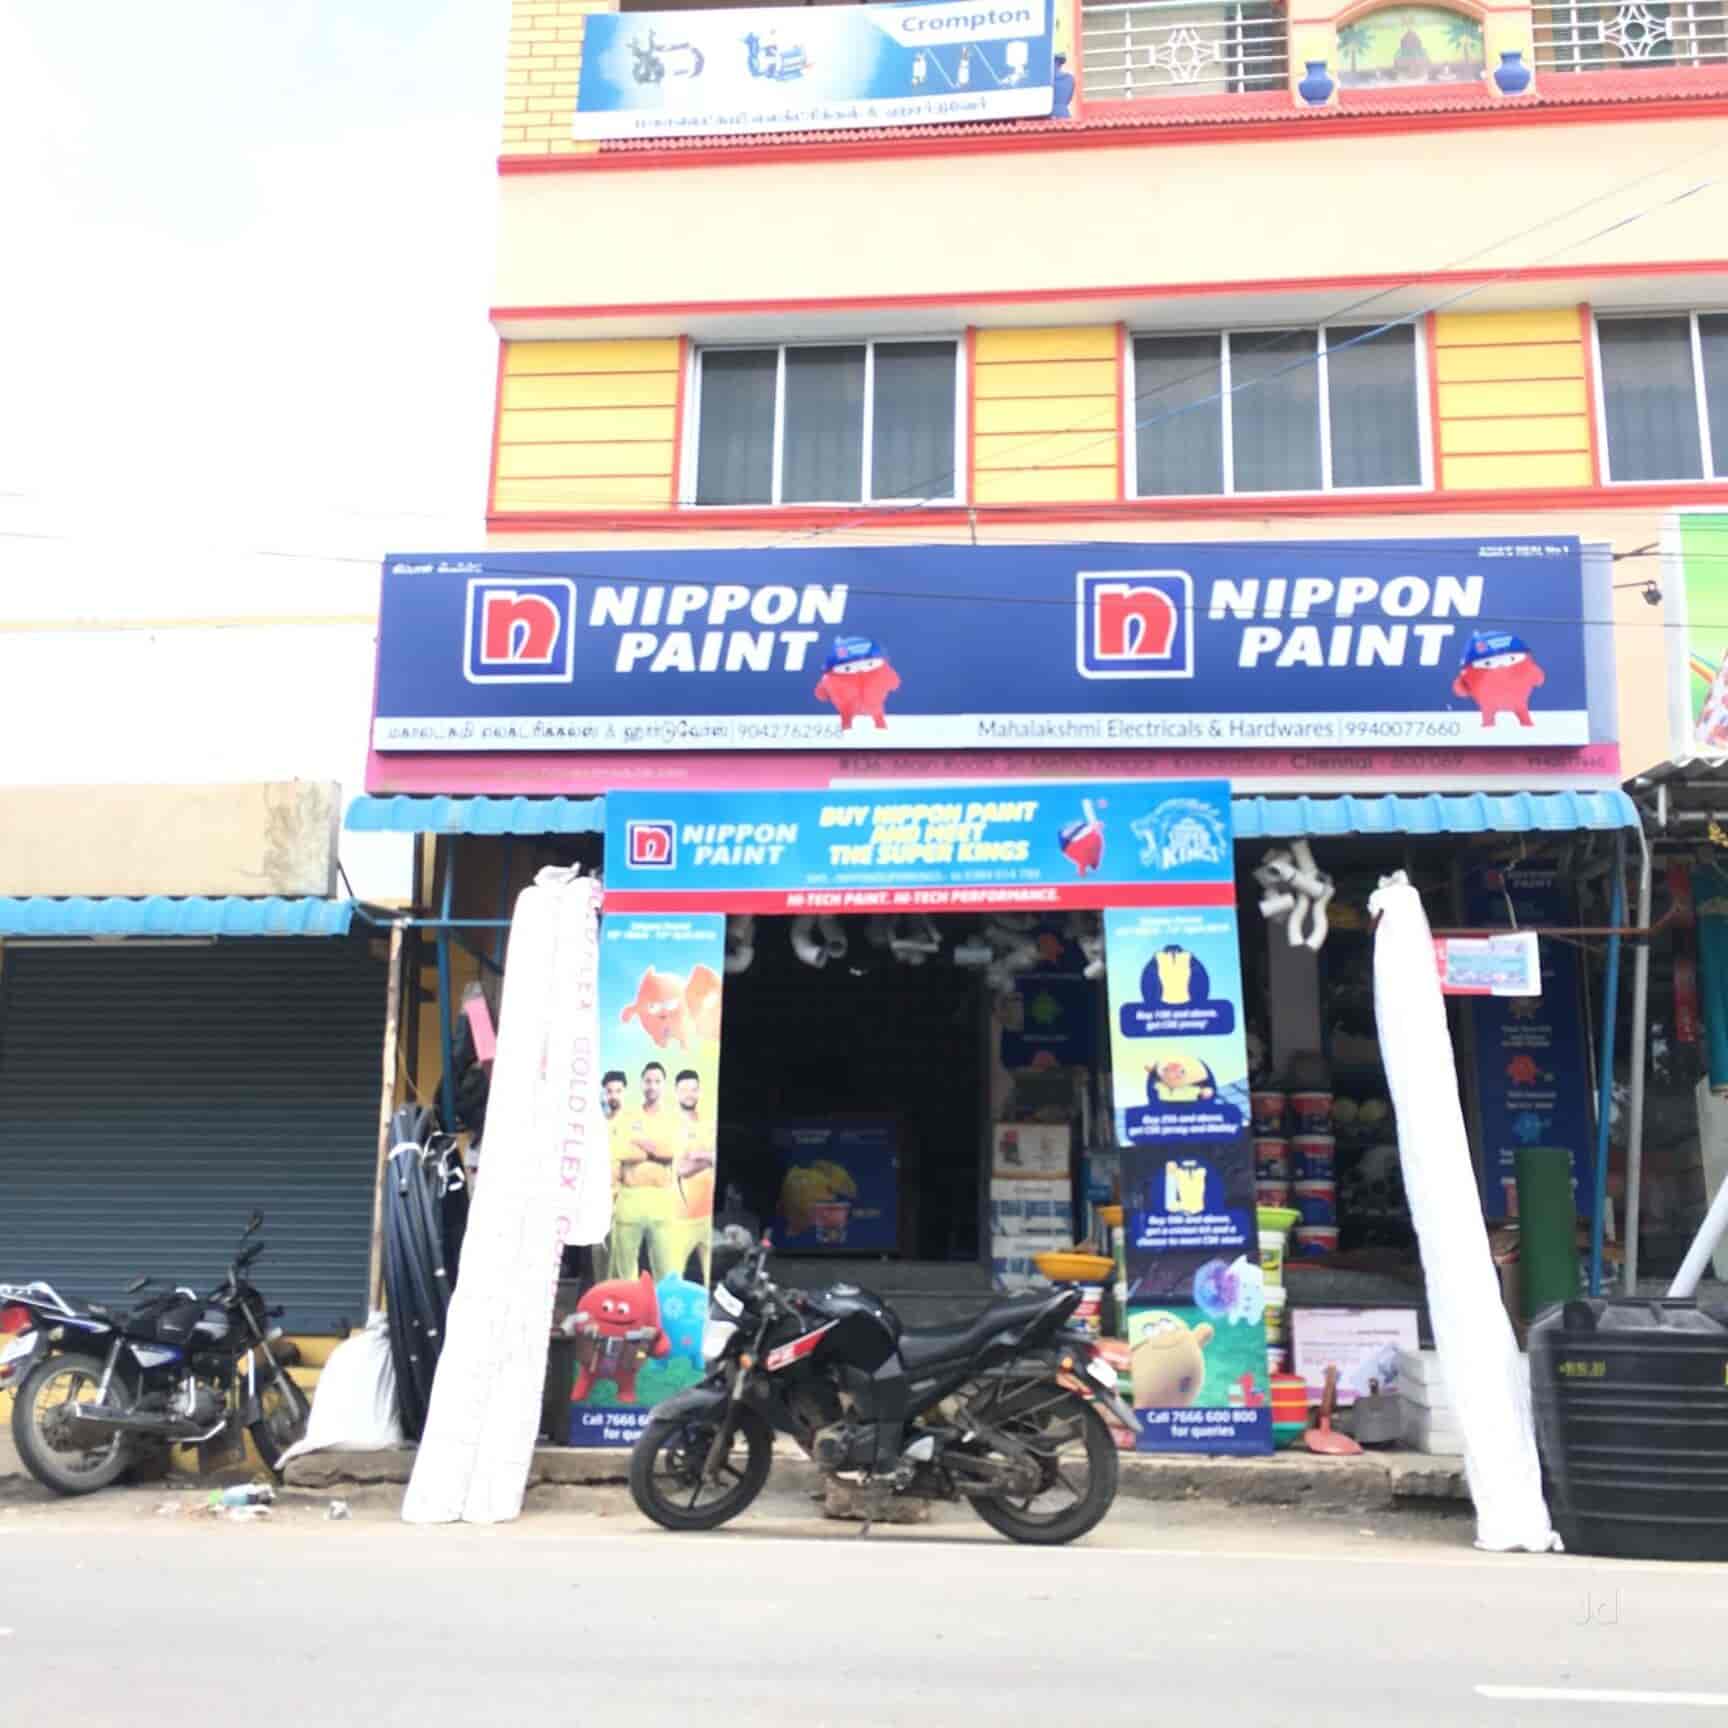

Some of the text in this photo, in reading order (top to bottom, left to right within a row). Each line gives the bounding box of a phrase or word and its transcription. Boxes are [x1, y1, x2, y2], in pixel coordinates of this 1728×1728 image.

[902, 9, 1031, 32] Crompton
[590, 583, 849, 627] NIPPON
[1208, 575, 1485, 620] NIPPON
[615, 631, 819, 674] PAINT
[1238, 625, 1456, 669] PAINT
[978, 719, 1461, 738] Mahalakshmi Electricals & Hardwares 9940077660
[819, 806, 869, 828] BUY
[965, 800, 1039, 822] PAINT
[681, 823, 798, 845] NIPPON
[693, 845, 786, 866] PAINT
[829, 844, 874, 866] THE
[956, 840, 1030, 862] KINGS
[560, 1121, 585, 1190] FLEX
[582, 1412, 604, 1426] Call
[606, 1412, 635, 1427] 7666
[1146, 1410, 1170, 1424] Call
[1172, 1410, 1204, 1423] 7666
[1205, 1410, 1231, 1423] 600
[603, 1426, 620, 1440] for
[1171, 1425, 1236, 1440] for queries
